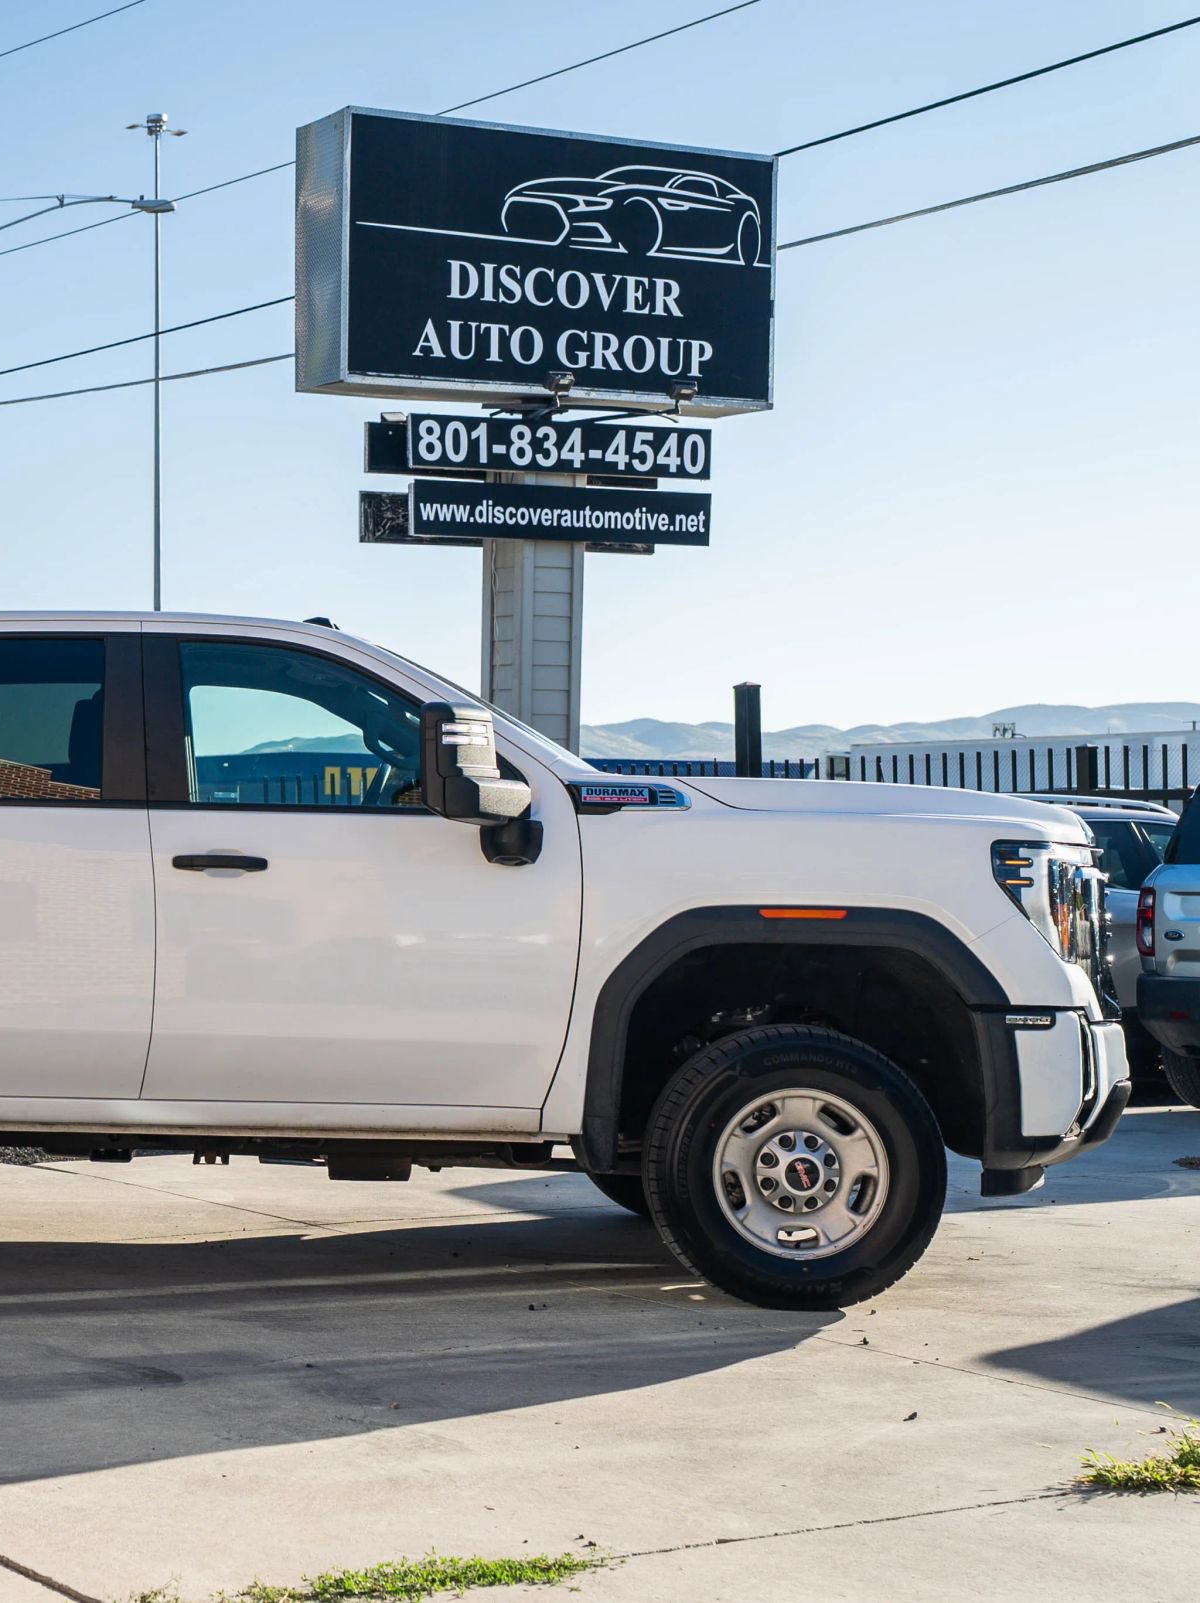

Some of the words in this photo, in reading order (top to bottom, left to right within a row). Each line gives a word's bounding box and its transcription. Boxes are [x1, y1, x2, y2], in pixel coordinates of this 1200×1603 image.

[446, 259, 683, 317] DISCOVER
[412, 318, 544, 364] AUTO
[556, 328, 713, 377] GROUP
[417, 419, 706, 474] 801-834-4540
[420, 500, 705, 533] www.discoverautomotive.net
[586, 788, 645, 797] DURAMAX
[793, 1160, 811, 1189] GMC
